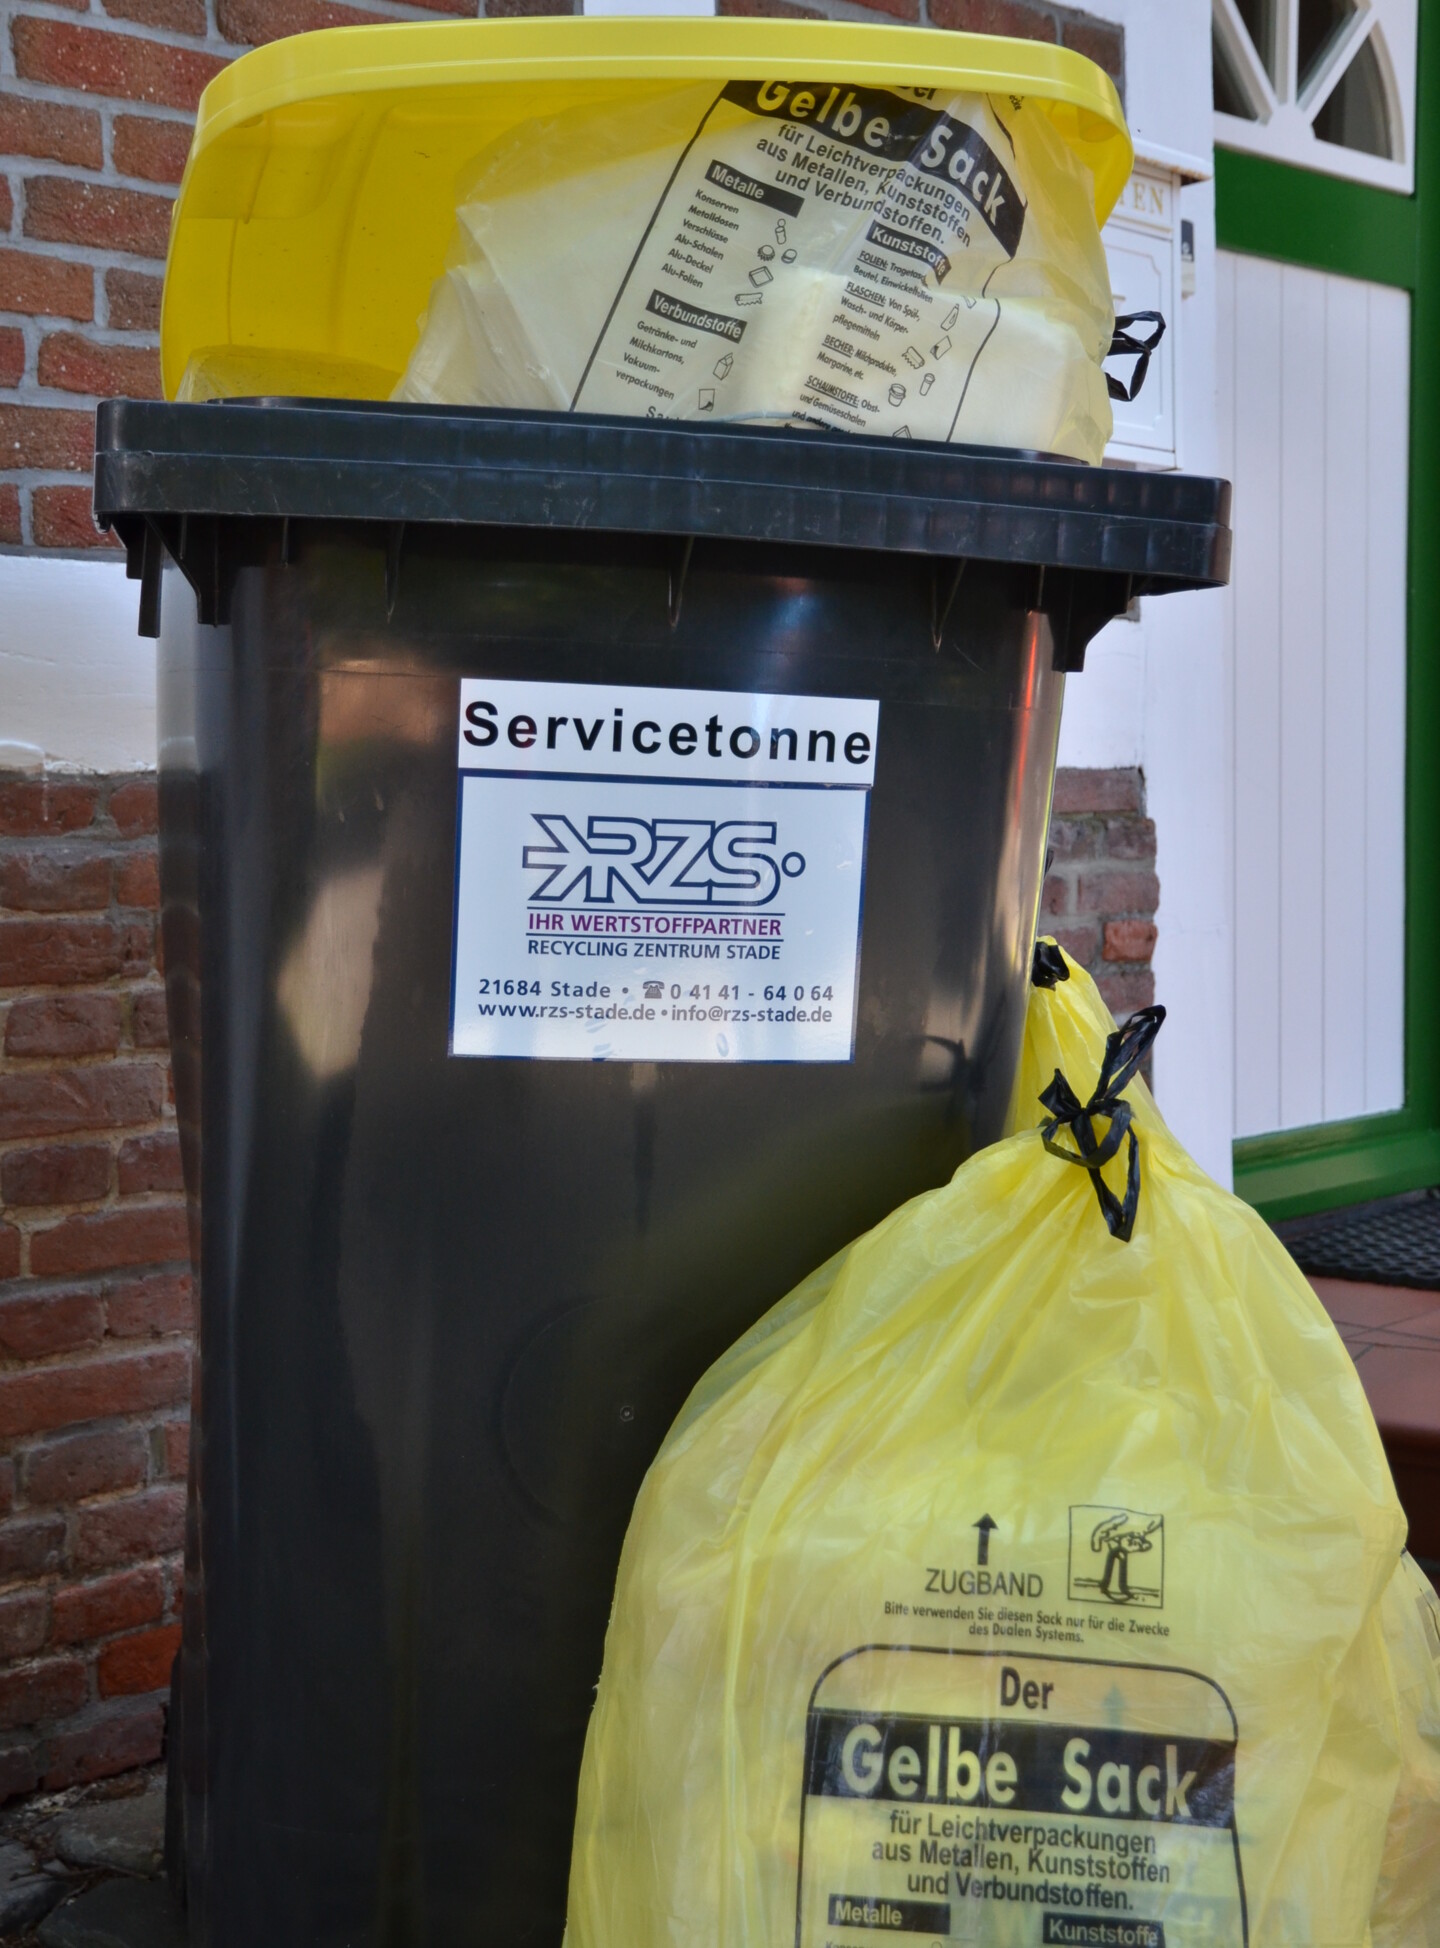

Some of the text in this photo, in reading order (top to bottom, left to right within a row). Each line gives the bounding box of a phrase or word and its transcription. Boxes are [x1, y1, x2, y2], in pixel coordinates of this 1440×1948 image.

[757, 80, 1005, 226] Gelbe Sack
[711, 164, 764, 199] Metalle
[778, 124, 971, 222] für Leichtverpackungen
[695, 189, 739, 214] Konserven
[756, 138, 970, 247] aus Metallen, Kunststoffen
[775, 169, 944, 244] und Verbundstoffen.
[682, 218, 729, 244] Verschlüsse
[688, 204, 739, 231] Metalldosen
[668, 248, 714, 274] Alu-Deckel
[674, 233, 724, 261] Alu-Schalen
[858, 250, 888, 271] FOLIEN:
[871, 226, 946, 276] Kunststoffe
[661, 263, 704, 289] Alu-Folien
[853, 264, 879, 284] Beutel,
[841, 295, 867, 315] Wasch-
[868, 311, 885, 323] und
[846, 281, 887, 306] FLASCHEN:
[888, 297, 902, 312] Von
[653, 294, 742, 339] Verbundstoffe
[832, 314, 880, 341] pflegemitteln
[636, 320, 698, 349] Getränke- und
[623, 352, 661, 374] Vakuum-
[629, 336, 685, 365] Milchkartons,
[615, 369, 675, 400] verpackungen
[800, 393, 866, 427] und Gemüseschalen
[462, 700, 871, 765] Servicetonne
[540, 814, 781, 906] RZS
[528, 913, 782, 936] IHR WERTSTOFFPARTNER
[528, 939, 781, 960] RECYCLING ZENTRUM STADE
[478, 978, 542, 996] 21684
[551, 981, 611, 998] Stade
[478, 1003, 656, 1021] www.rzs-stade.de
[925, 1568, 1043, 1598] ZUGBAND
[884, 1601, 1170, 1636] Bitte verwenden Sie diesen Sack nur für die Zwecke
[968, 1622, 1084, 1643] des Dualen Systems.
[1000, 1666, 1054, 1710] Der
[842, 1723, 1200, 1818] Gelbe Sack
[890, 1810, 1157, 1858] für Leichtverpackungen
[871, 1840, 1170, 1884] aus Metallen, Kunststoffen
[907, 1871, 1134, 1910] und Verbundstoffen.
[835, 1900, 1158, 1945] Metalle Kunststoffe
